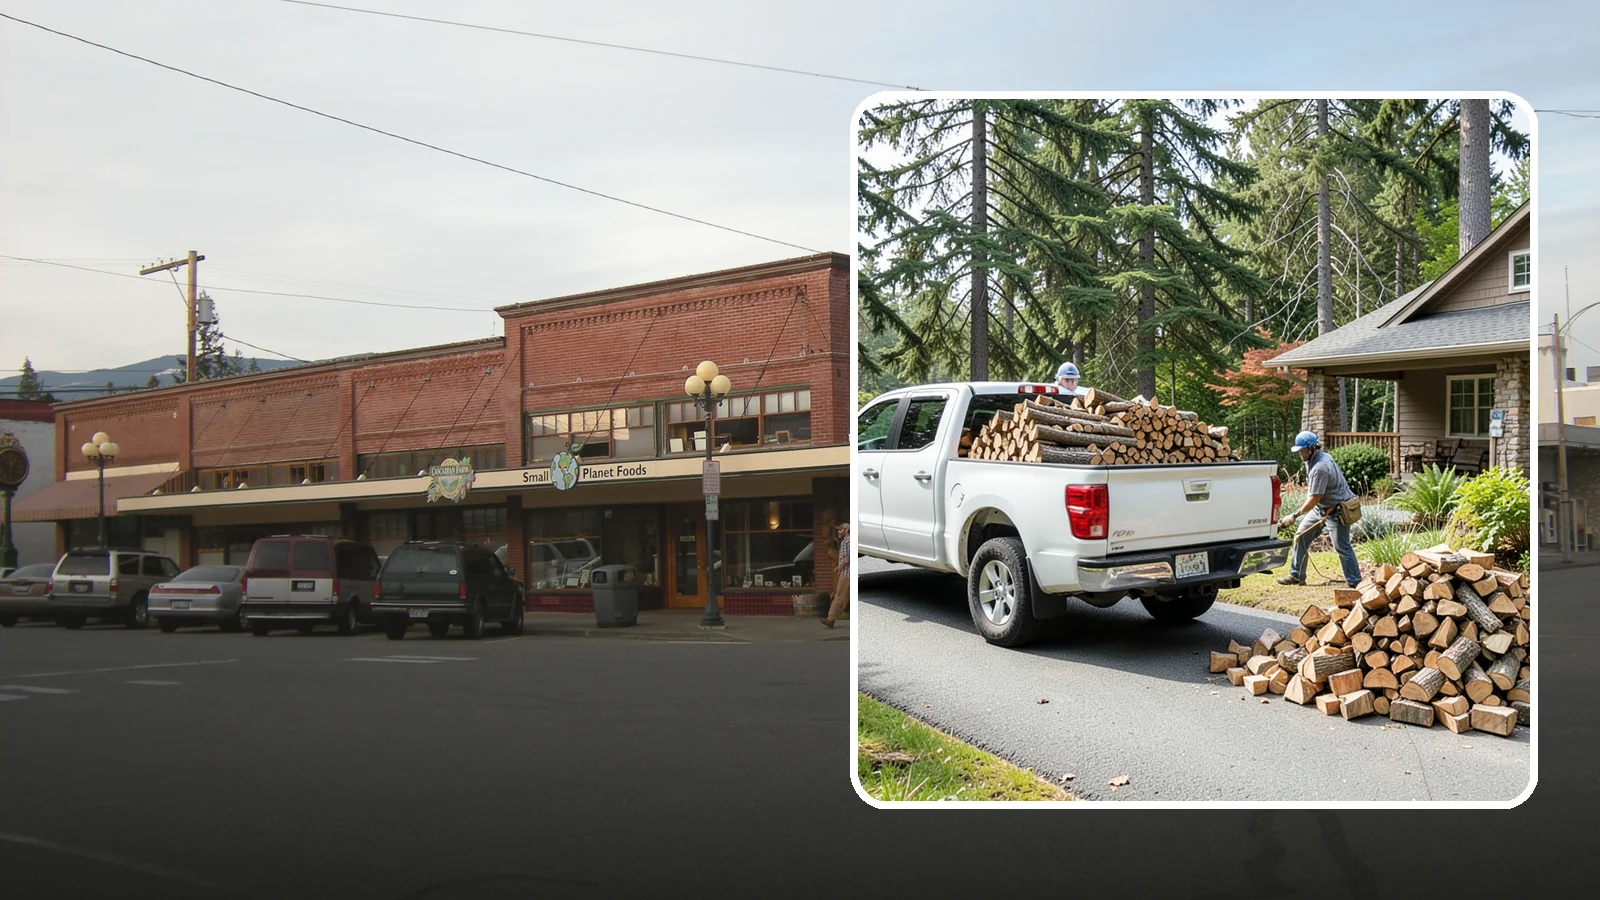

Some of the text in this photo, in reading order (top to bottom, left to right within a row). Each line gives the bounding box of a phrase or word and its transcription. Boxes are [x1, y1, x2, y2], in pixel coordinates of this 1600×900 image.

[523, 464, 647, 483] Small Planet Foods
